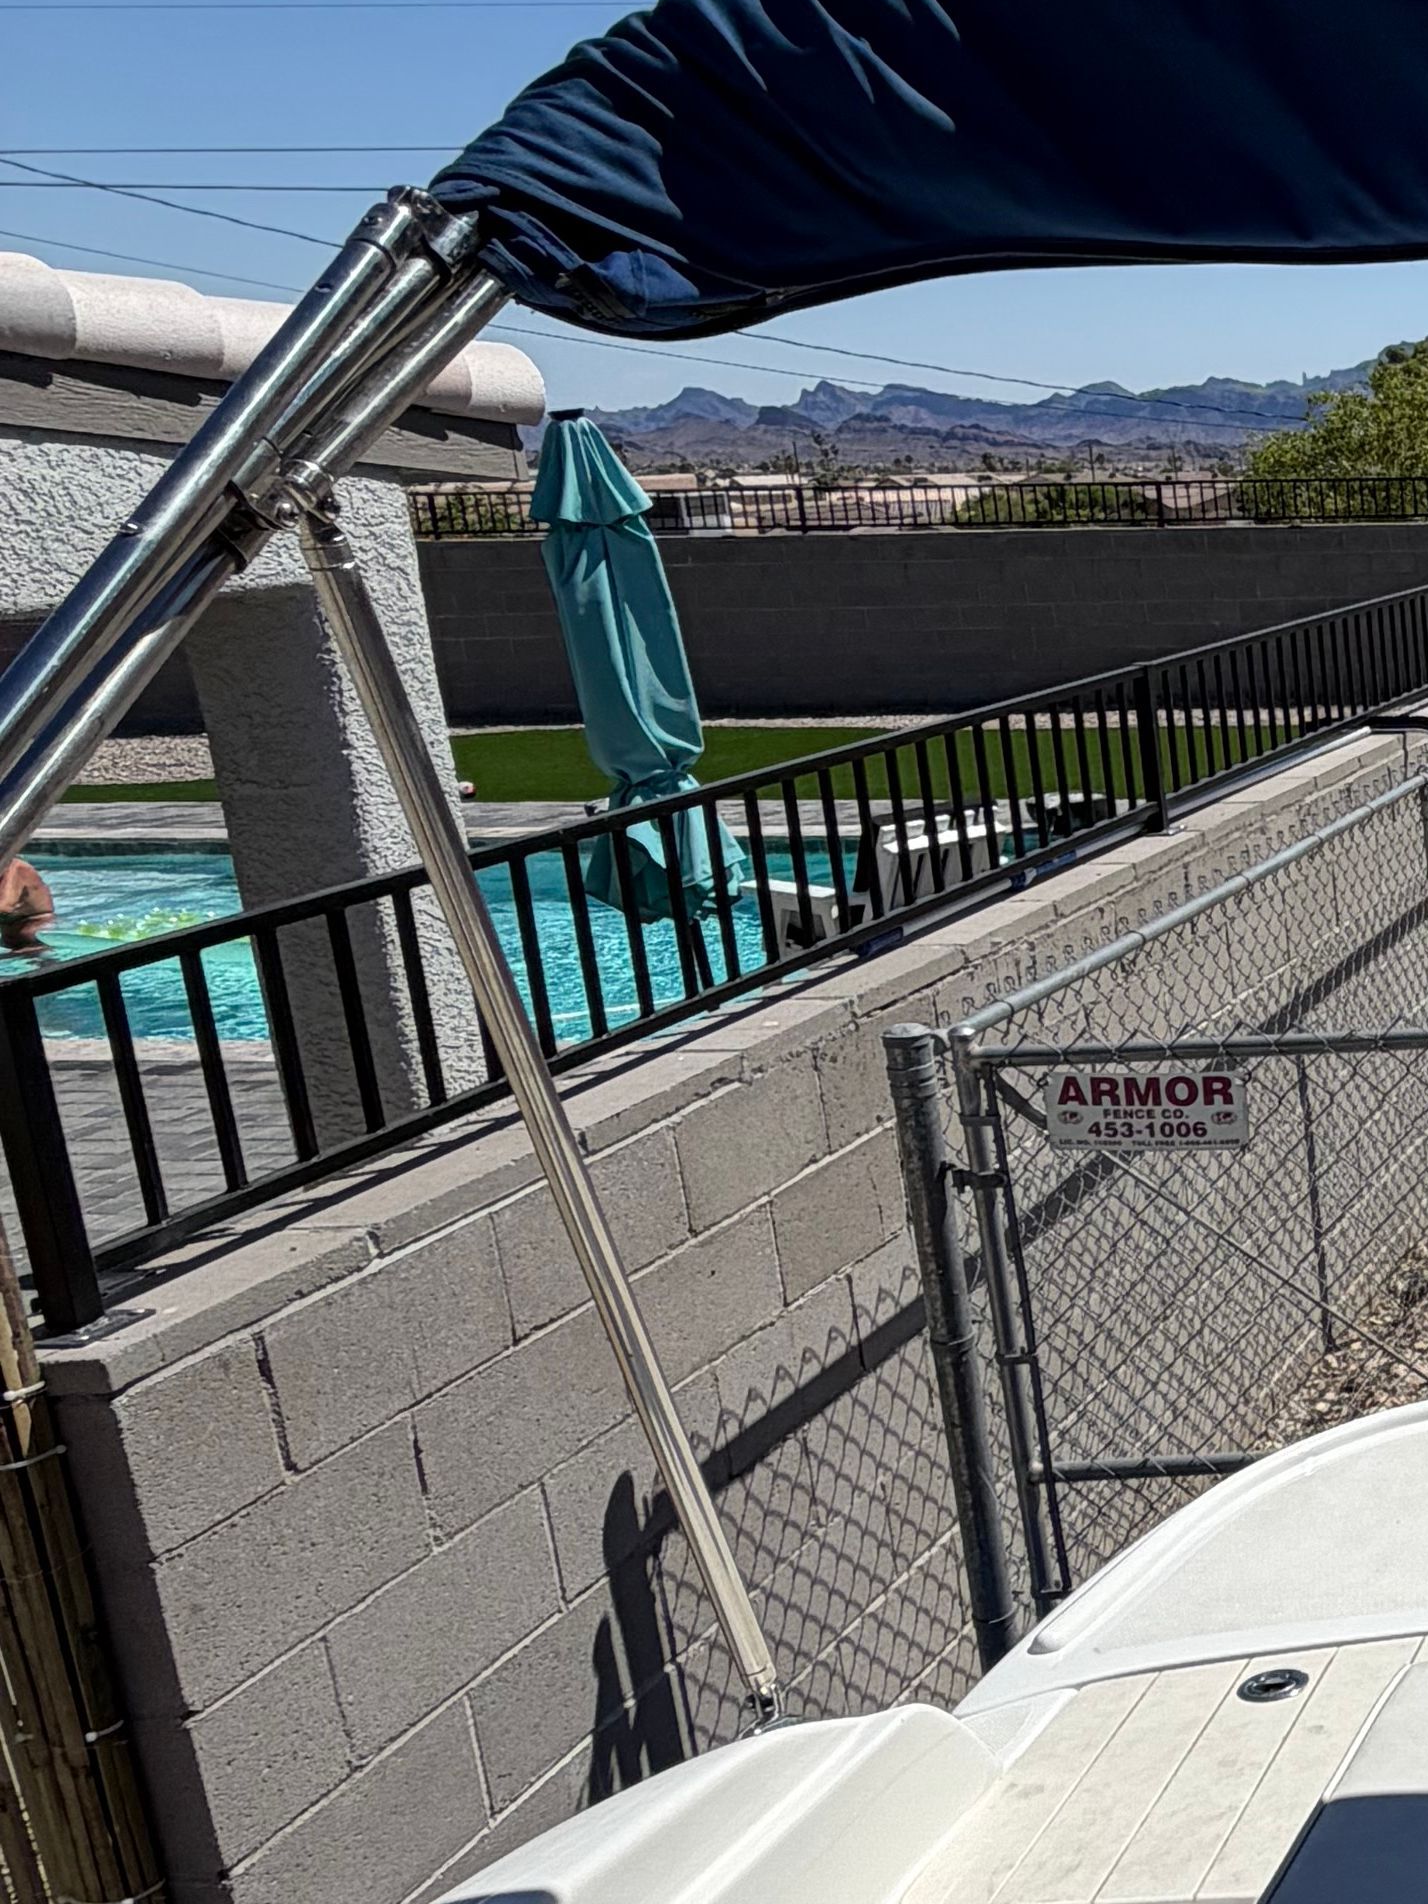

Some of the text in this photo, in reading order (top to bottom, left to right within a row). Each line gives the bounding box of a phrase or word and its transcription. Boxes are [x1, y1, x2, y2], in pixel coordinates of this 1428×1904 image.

[1057, 1075, 1234, 1107] ARMOR
[1102, 1108, 1190, 1120] FENCE CO.
[1087, 1121, 1208, 1138] 453-1006
